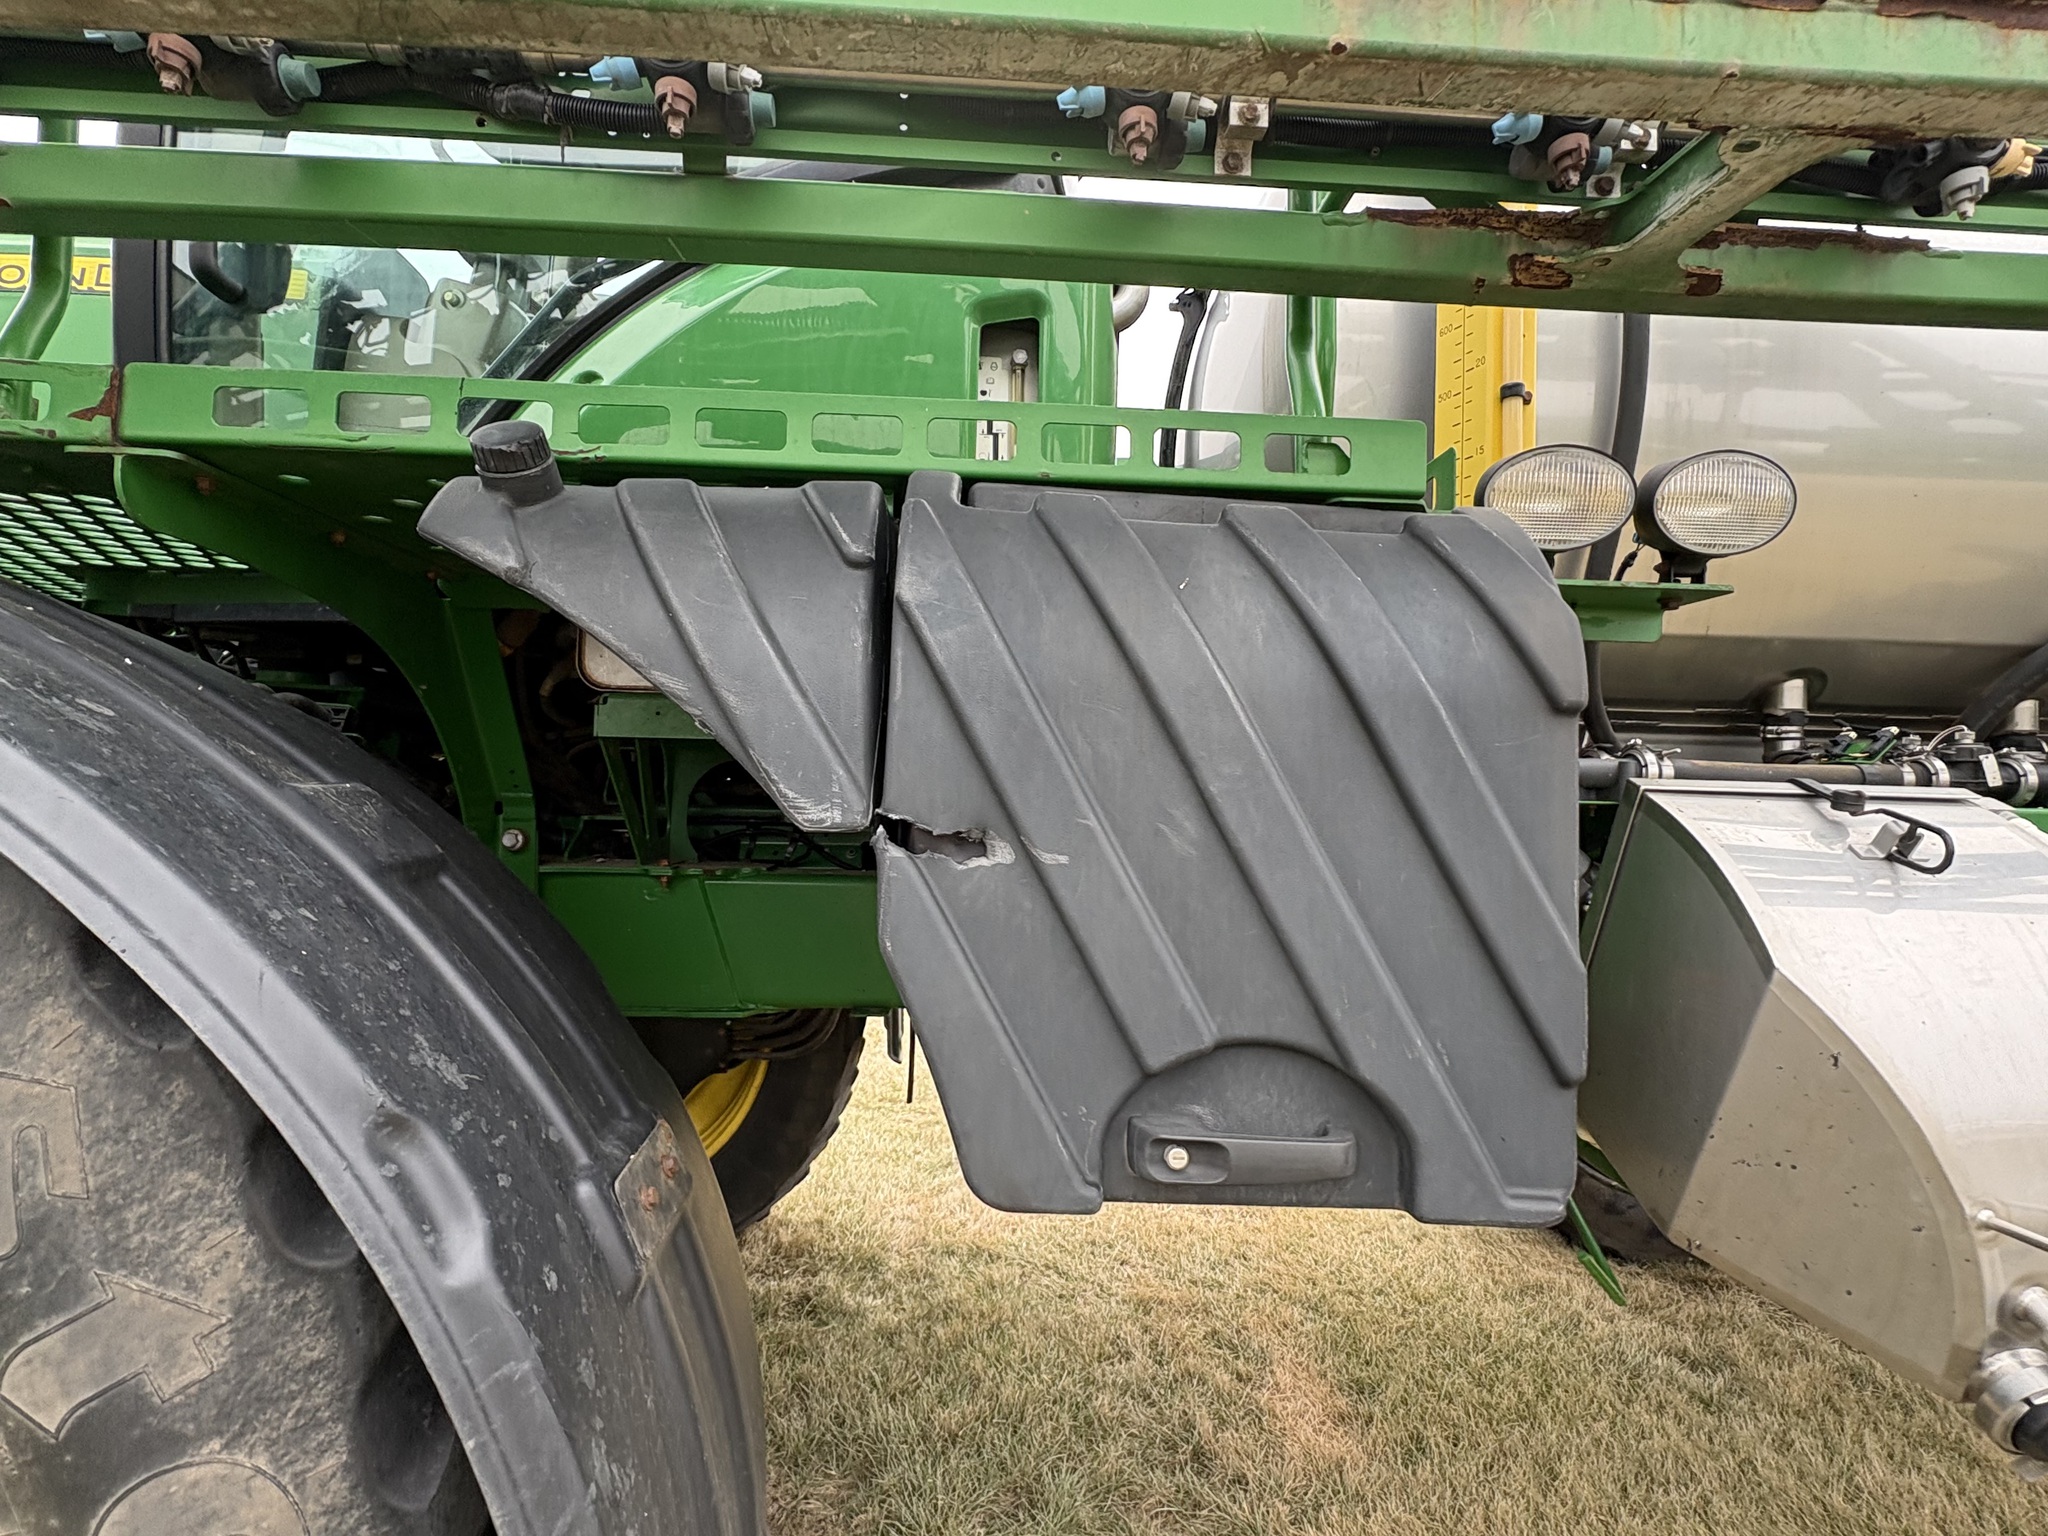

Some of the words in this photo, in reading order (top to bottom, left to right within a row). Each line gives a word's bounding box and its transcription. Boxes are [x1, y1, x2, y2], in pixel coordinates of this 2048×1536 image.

[1439, 323, 1453, 337] 600
[1475, 355, 1486, 368] 20
[1438, 389, 1452, 403] 500
[1475, 444, 1485, 456] 15
